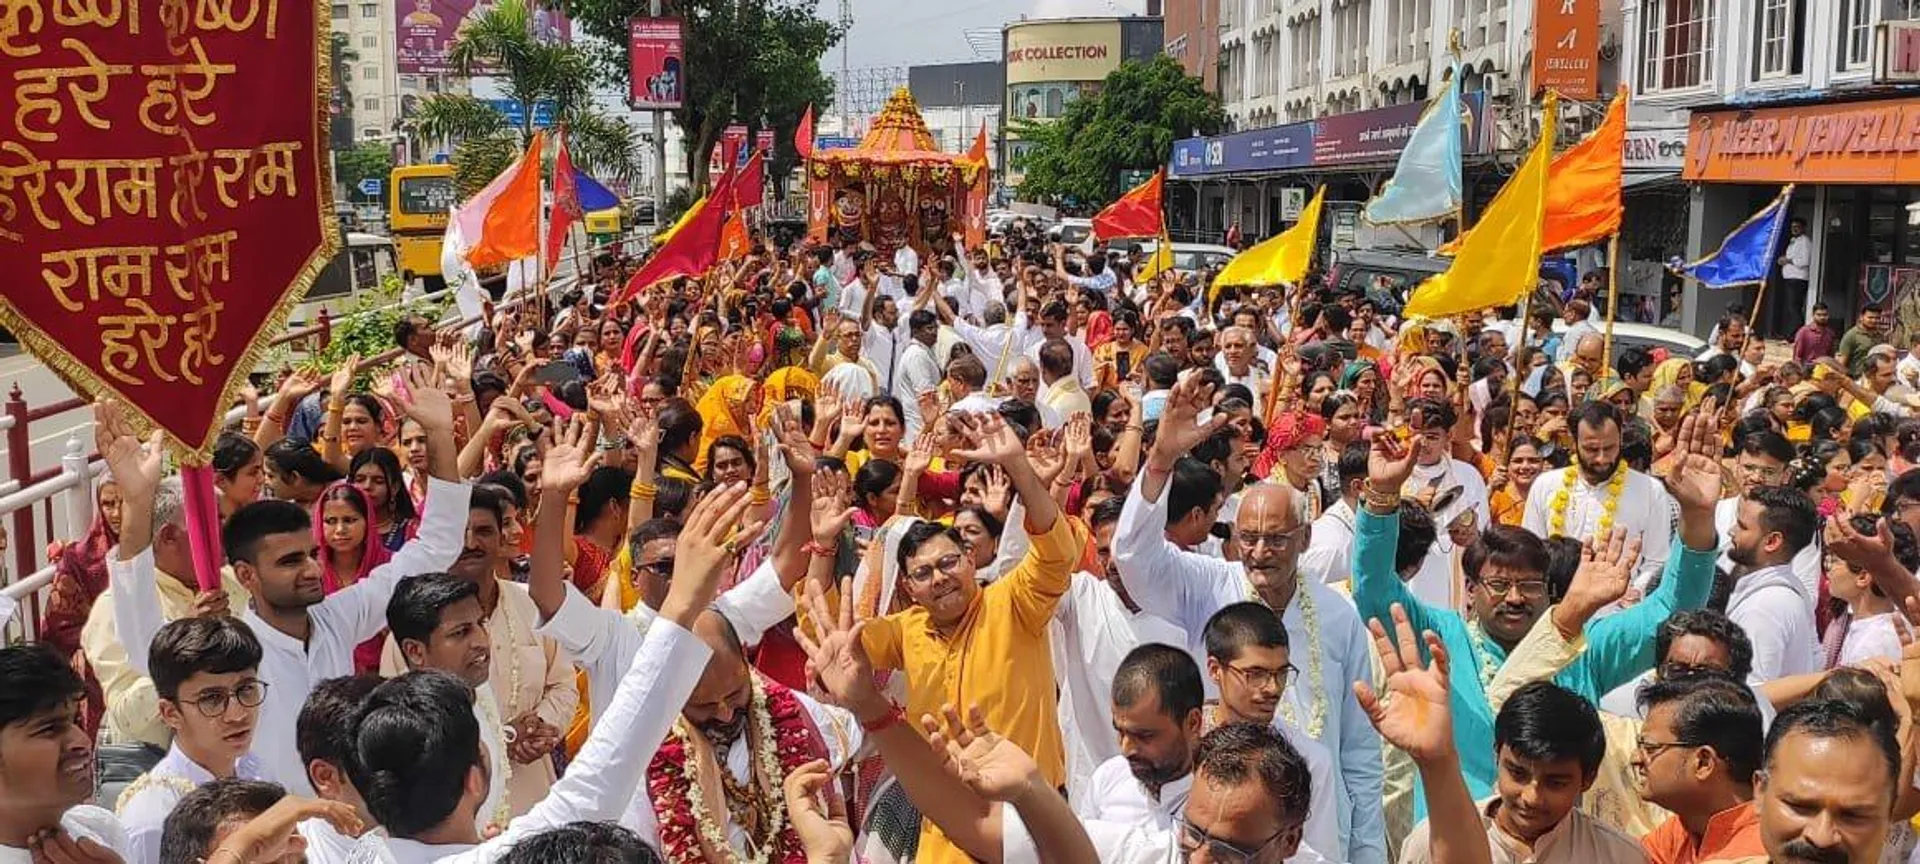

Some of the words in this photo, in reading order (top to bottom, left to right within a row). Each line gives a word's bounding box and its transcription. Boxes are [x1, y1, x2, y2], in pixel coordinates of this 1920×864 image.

[14, 38, 133, 141] हरे
[139, 37, 236, 134] हरे
[1025, 45, 1107, 60] COLLECTION
[55, 158, 163, 225] राम
[213, 141, 302, 208] राम
[41, 246, 158, 312] राम
[98, 298, 177, 385] हरे
